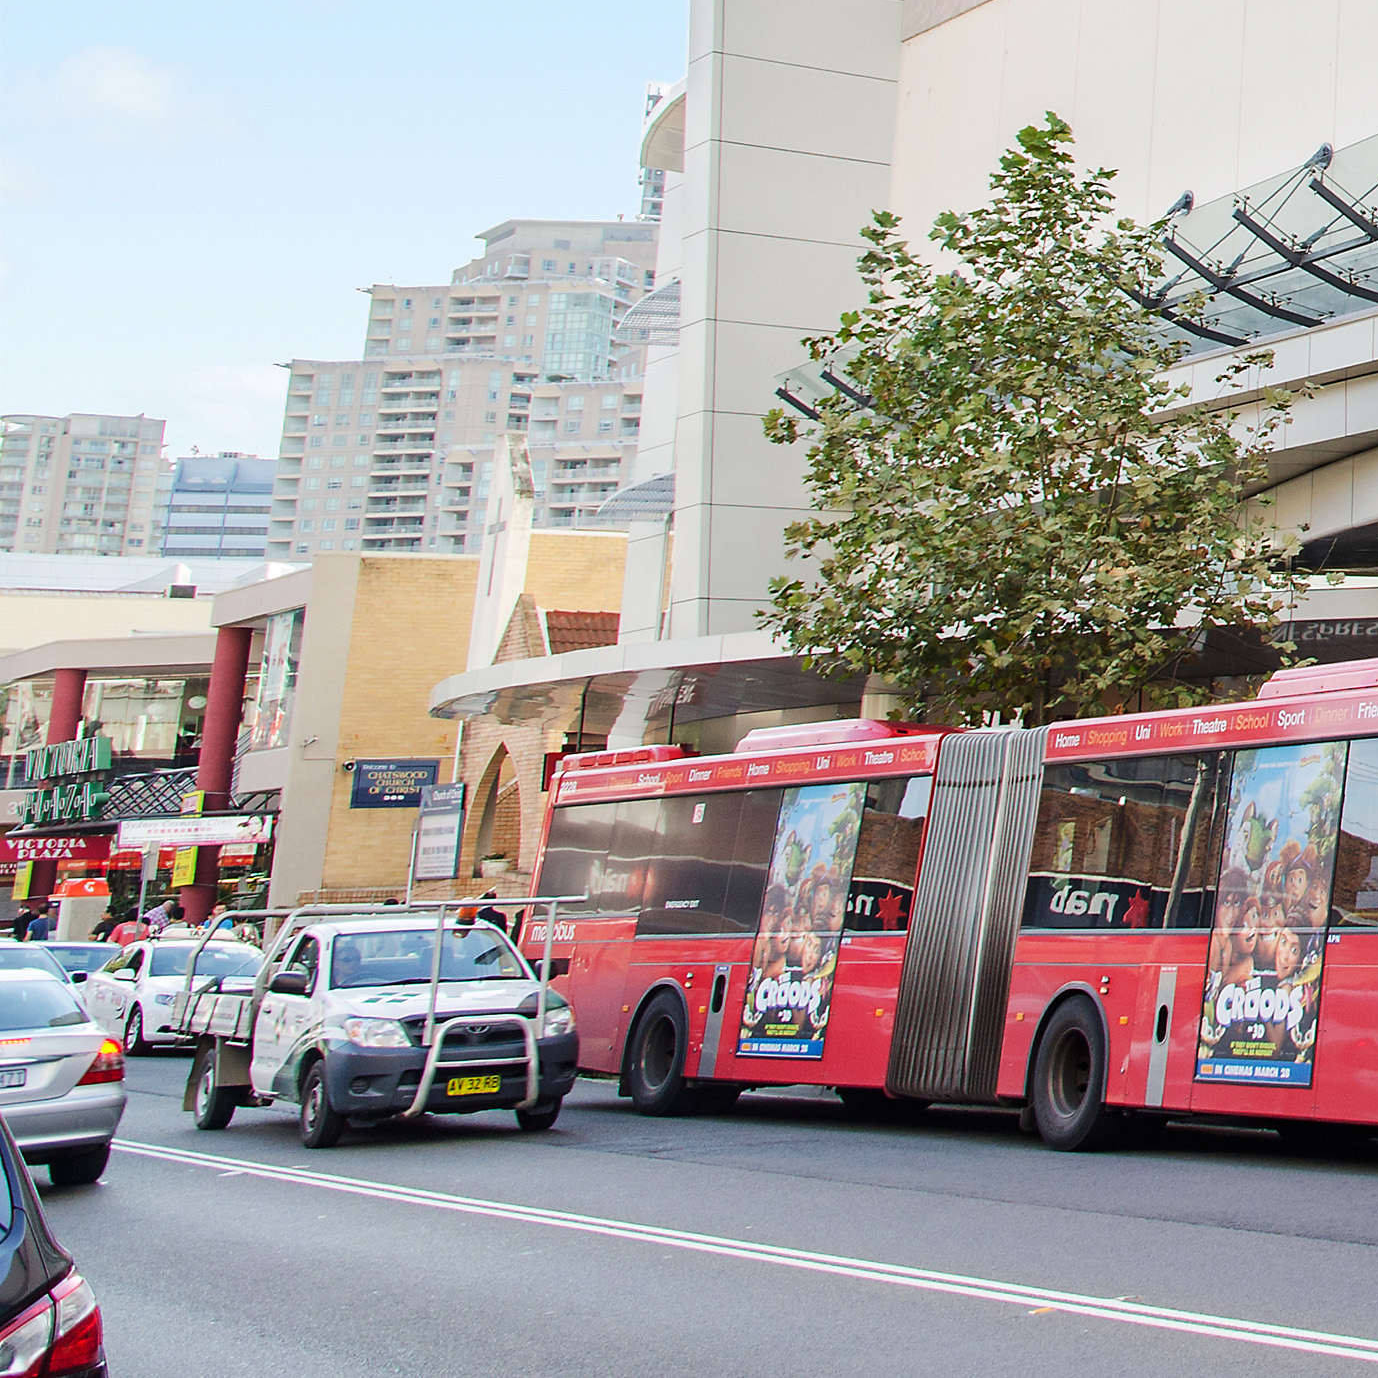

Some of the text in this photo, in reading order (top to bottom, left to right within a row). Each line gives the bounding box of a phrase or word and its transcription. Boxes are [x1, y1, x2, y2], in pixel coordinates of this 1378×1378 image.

[1055, 732, 1080, 748] Home
[1087, 728, 1128, 747] Shopping
[1135, 724, 1151, 741] Uni
[1160, 722, 1183, 738] Work
[1192, 718, 1227, 734] Theatre
[1235, 713, 1269, 730] School
[1277, 709, 1305, 727] Sport
[1314, 705, 1349, 723] Dinner
[368, 771, 428, 779] CHATSWOOD
[638, 772, 661, 786] School
[688, 769, 712, 782] Dinner
[748, 763, 770, 776] Home
[776, 760, 810, 774] Shopping
[816, 756, 830, 770] Uni
[836, 755, 857, 767] Work
[864, 752, 894, 766] Theatre
[368, 786, 420, 794] OF CHRIST
[6, 838, 87, 849] VICTORIA
[17, 849, 72, 859] PLAZA
[531, 922, 576, 941] meobus
[1327, 935, 1341, 943] APN
[779, 972, 791, 983] THE
[1245, 977, 1261, 991] THE
[756, 977, 821, 1014] CROODS
[1216, 983, 1304, 1031] CROODS
[1252, 1023, 1265, 1039] 3D
[1224, 1065, 1253, 1076] CINEMAS
[1254, 1066, 1279, 1077] MARCH
